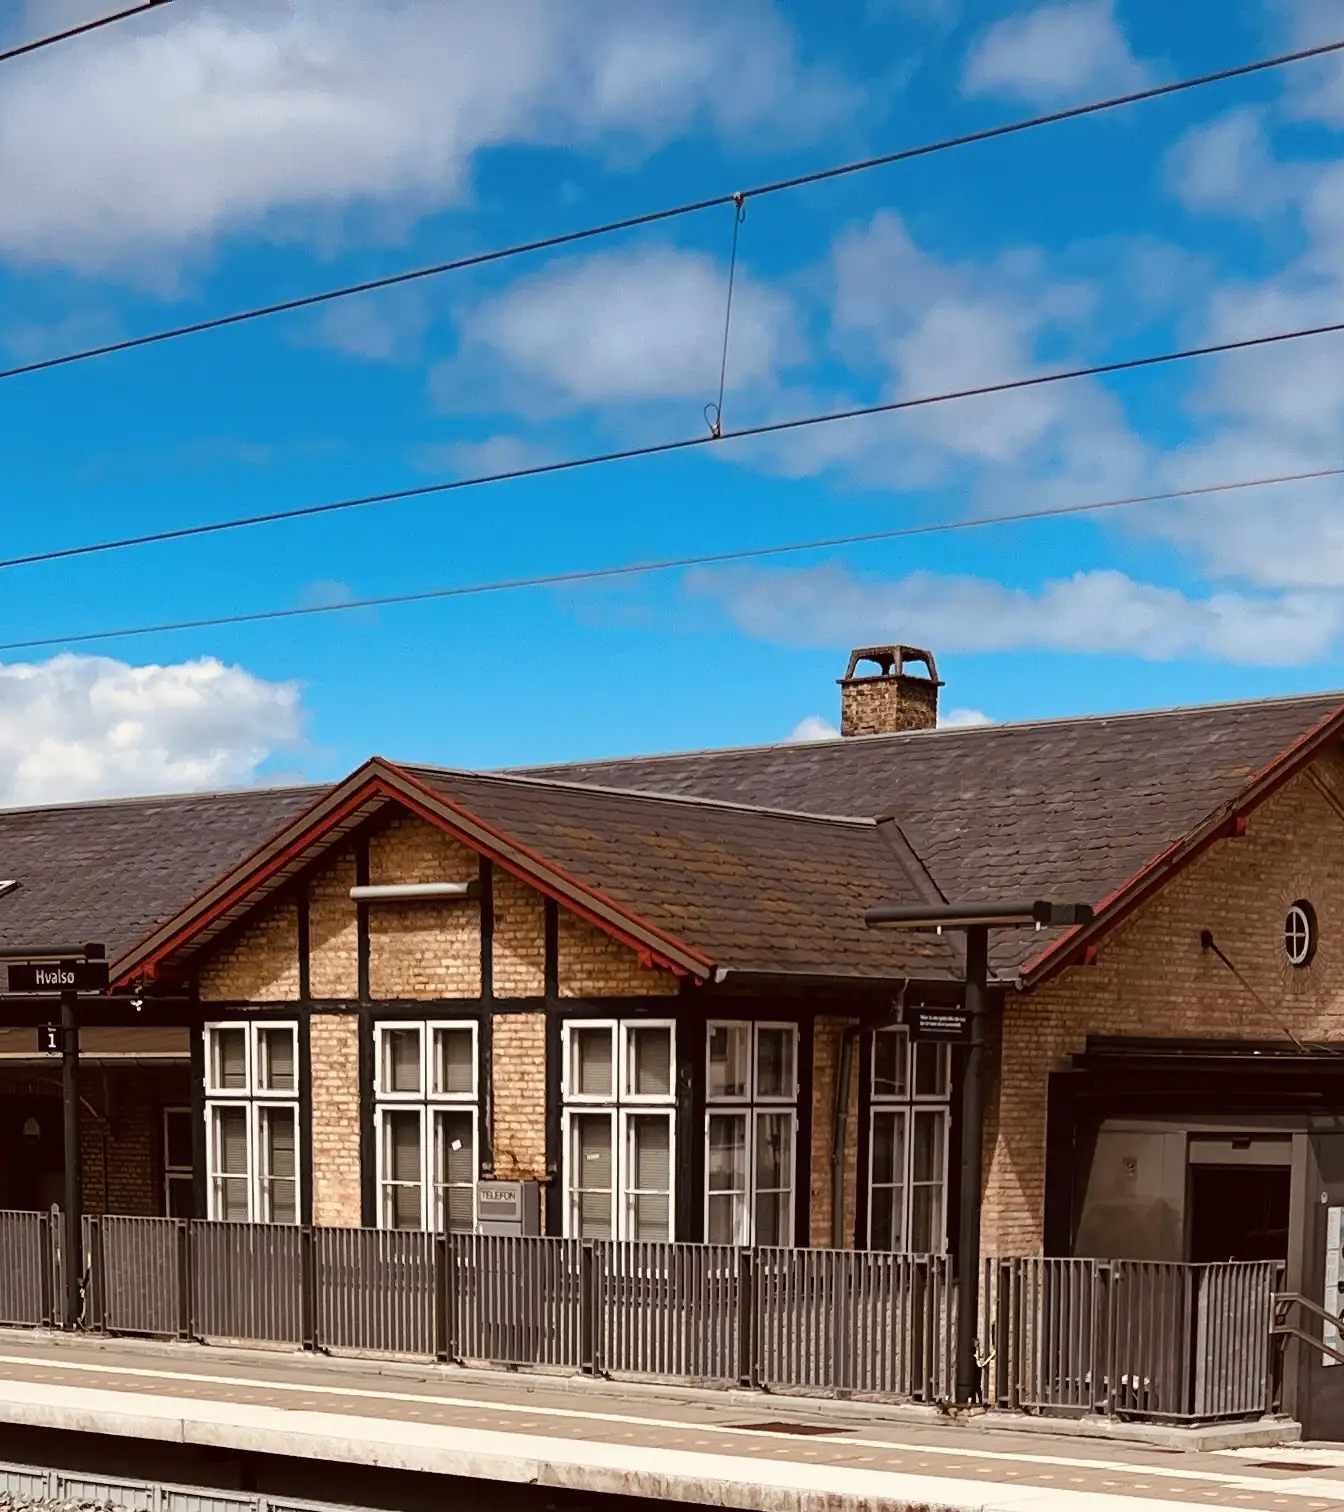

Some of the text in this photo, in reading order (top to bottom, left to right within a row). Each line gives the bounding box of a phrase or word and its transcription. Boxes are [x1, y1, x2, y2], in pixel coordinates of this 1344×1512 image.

[36, 968, 74, 984] Hvalsø
[48, 1033, 56, 1048] 1
[481, 1191, 516, 1201] TELEFON
